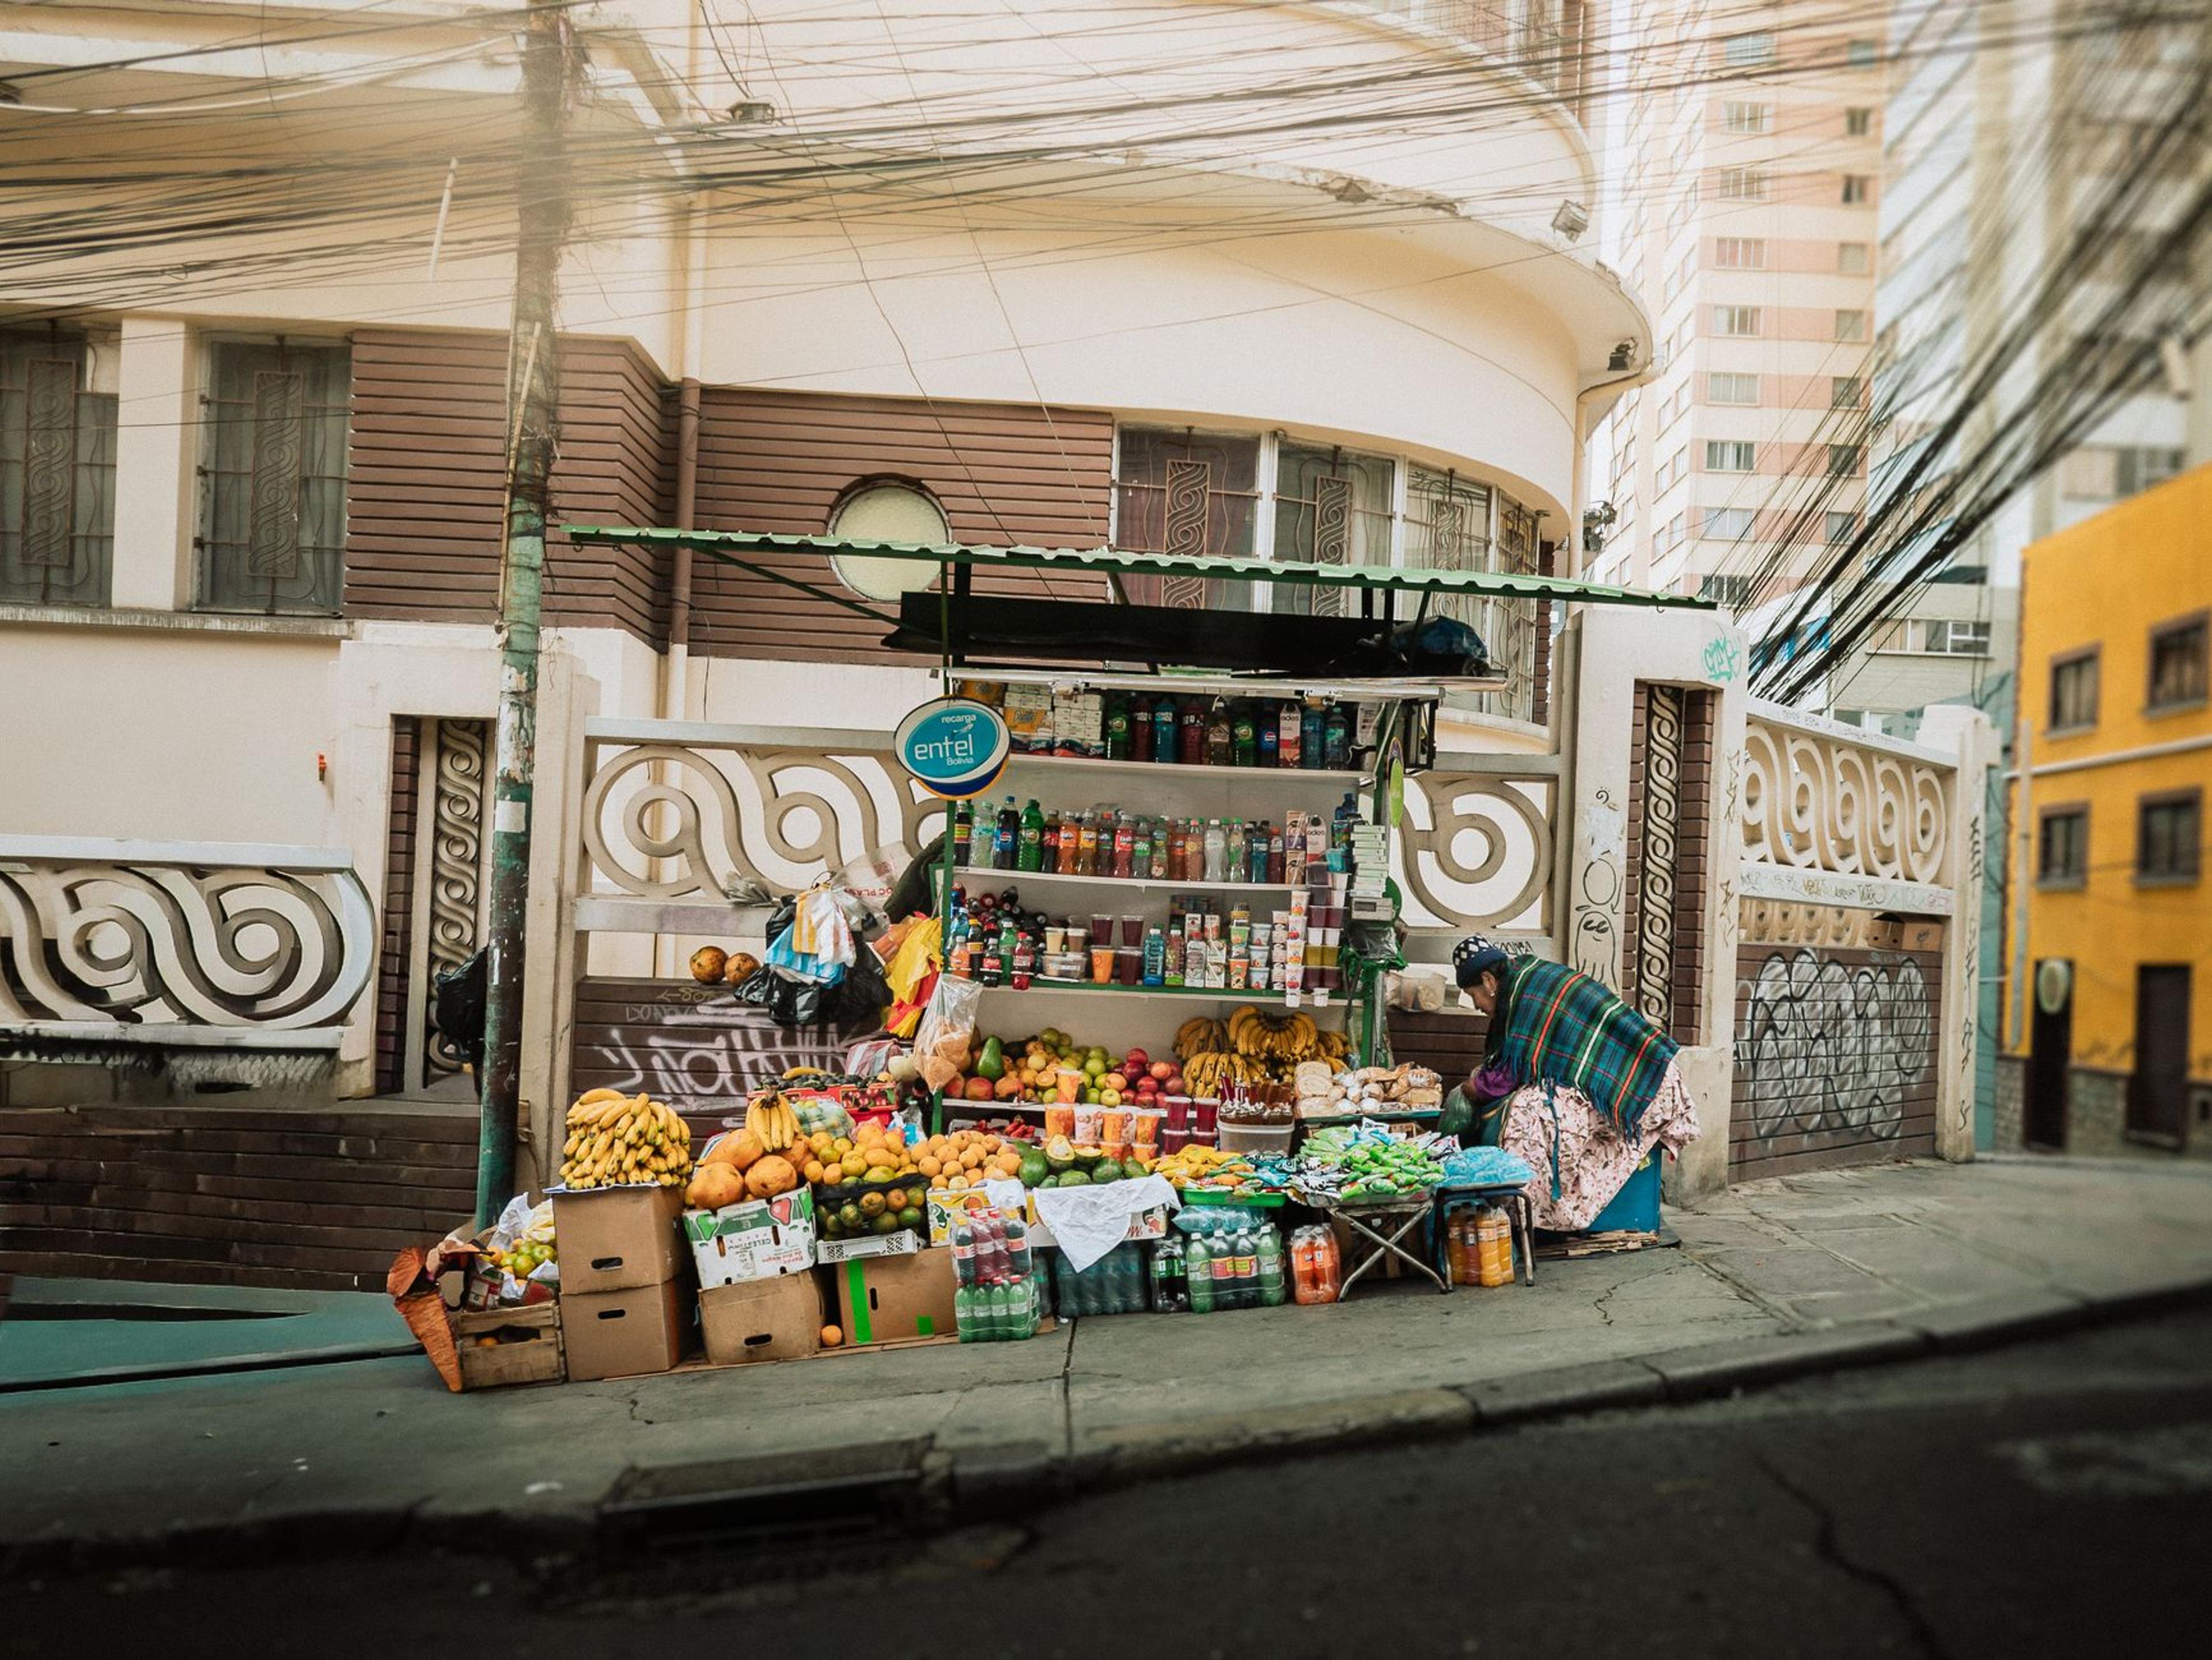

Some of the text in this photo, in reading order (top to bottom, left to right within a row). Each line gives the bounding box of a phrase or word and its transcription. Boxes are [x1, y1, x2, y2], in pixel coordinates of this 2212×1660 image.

[941, 714, 977, 724] recarga
[914, 733, 974, 761] entel
[946, 757, 975, 766] Bolivia
